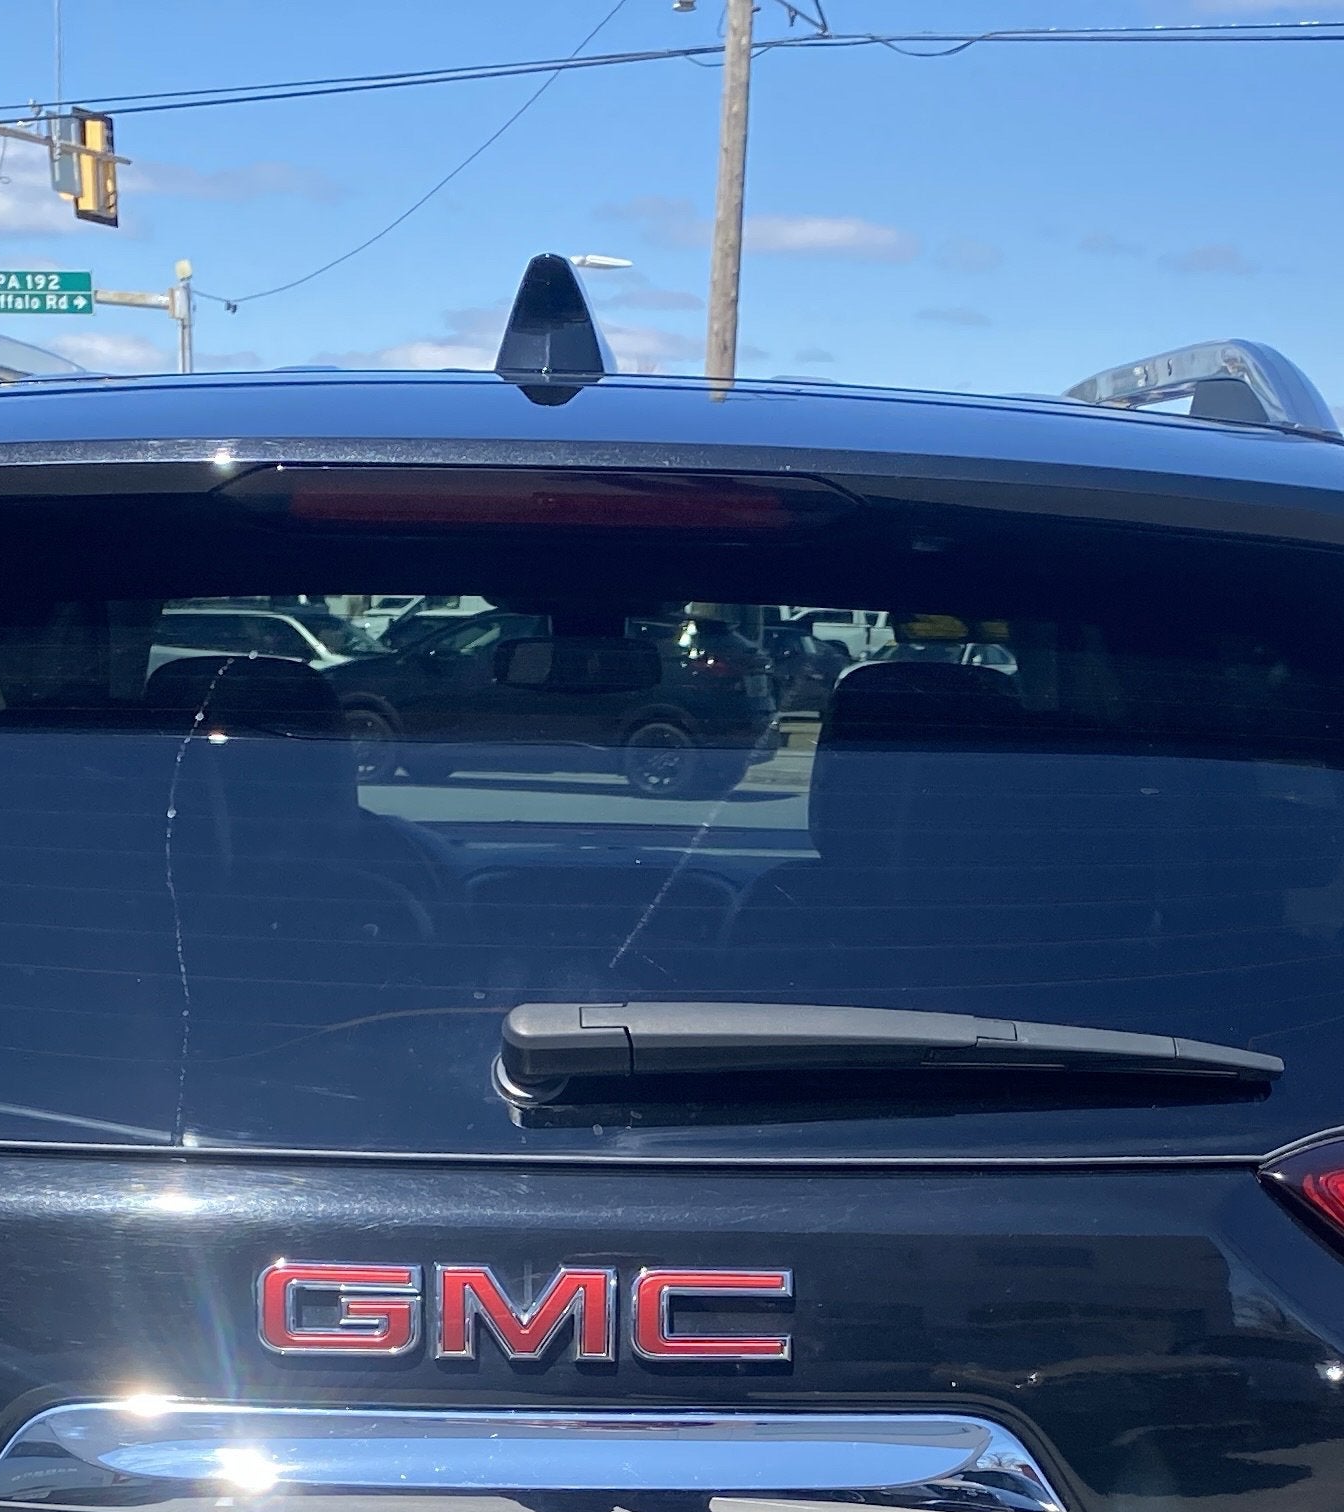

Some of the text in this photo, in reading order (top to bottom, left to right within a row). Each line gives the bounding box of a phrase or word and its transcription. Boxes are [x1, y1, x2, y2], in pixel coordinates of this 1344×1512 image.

[25, 274, 61, 290] 192
[45, 294, 69, 309] Rd
[256, 1259, 793, 1361] GMC
